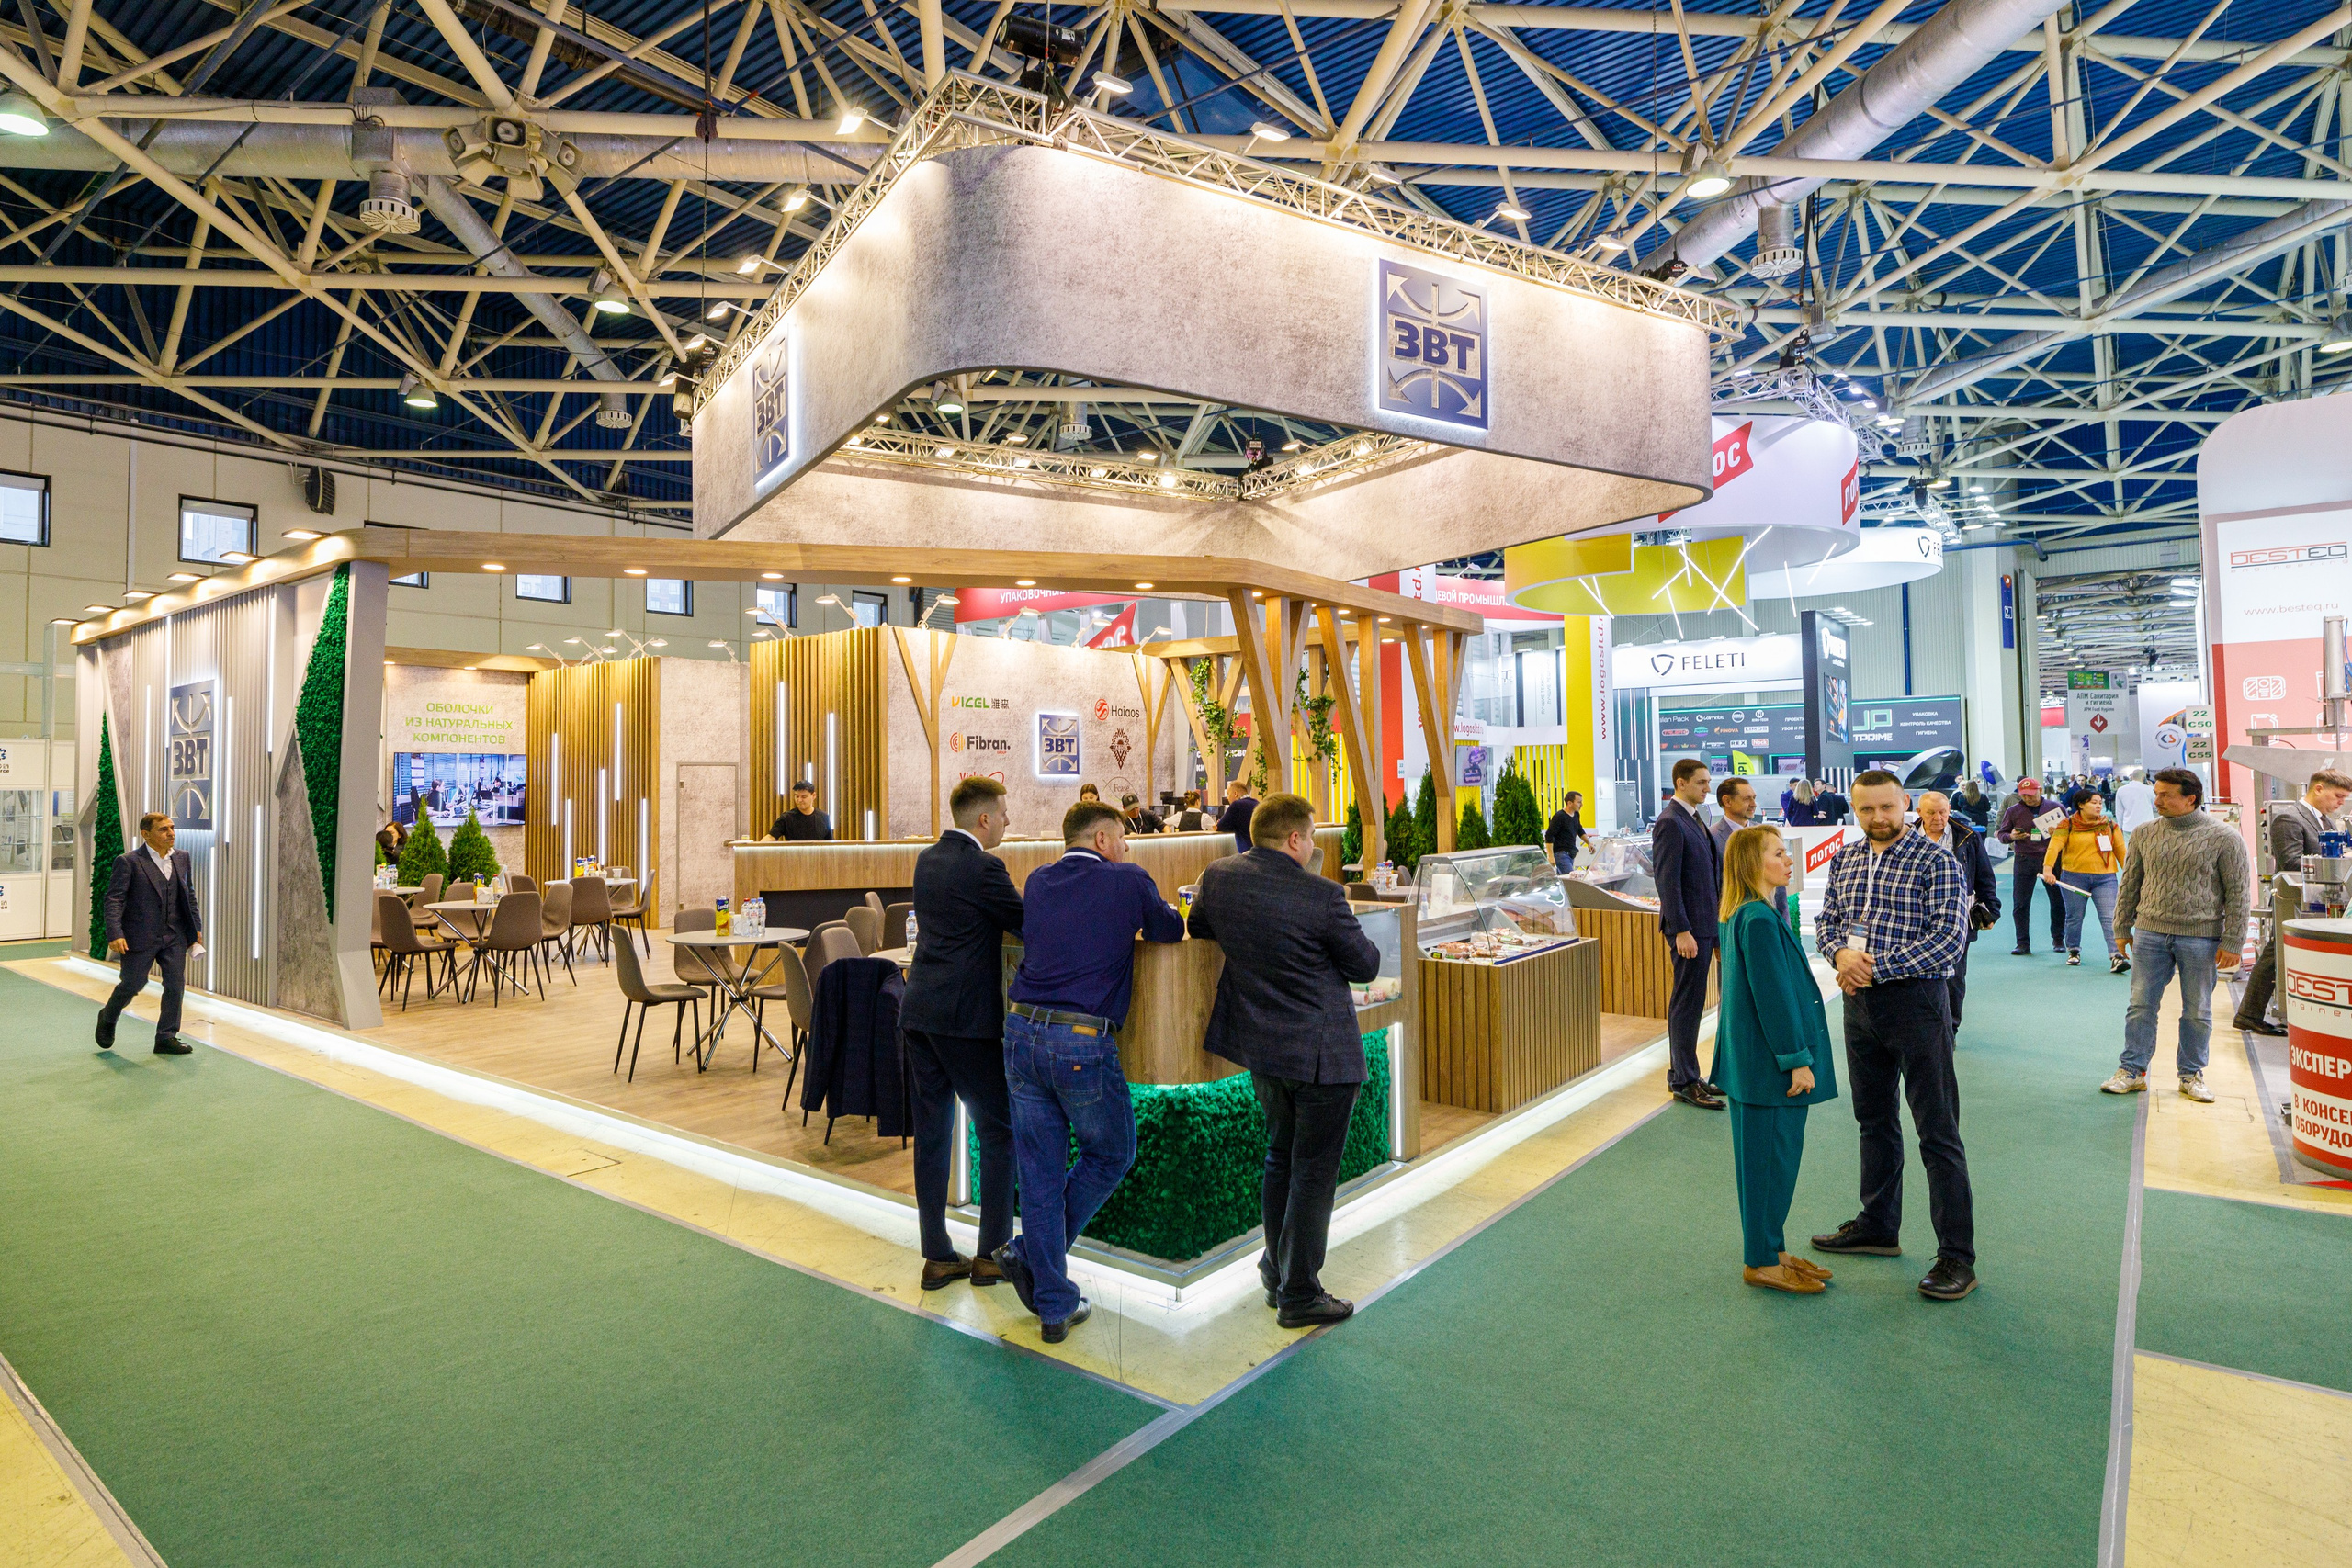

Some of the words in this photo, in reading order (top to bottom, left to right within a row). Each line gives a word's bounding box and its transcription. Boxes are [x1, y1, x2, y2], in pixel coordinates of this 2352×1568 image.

[1394, 319, 1475, 371] ЗВТ
[757, 378, 785, 435] ЗВТ
[2243, 603, 2339, 615] www.besteq.ru
[1682, 652, 1745, 670] FELETI
[426, 703, 494, 715] ОБОЛОЧКИ
[951, 696, 990, 708] VICEL
[1111, 705, 1140, 718] Haiaos
[405, 717, 423, 727] ИЗ
[425, 719, 514, 730] НАТУРАЛЬНЫХ
[413, 733, 505, 744] КОМПОНЕНТОВ
[1044, 738, 1075, 753] ЗВТ
[174, 738, 209, 776] ЗВТ
[2302, 1097, 2352, 1126] КОНСЕ
